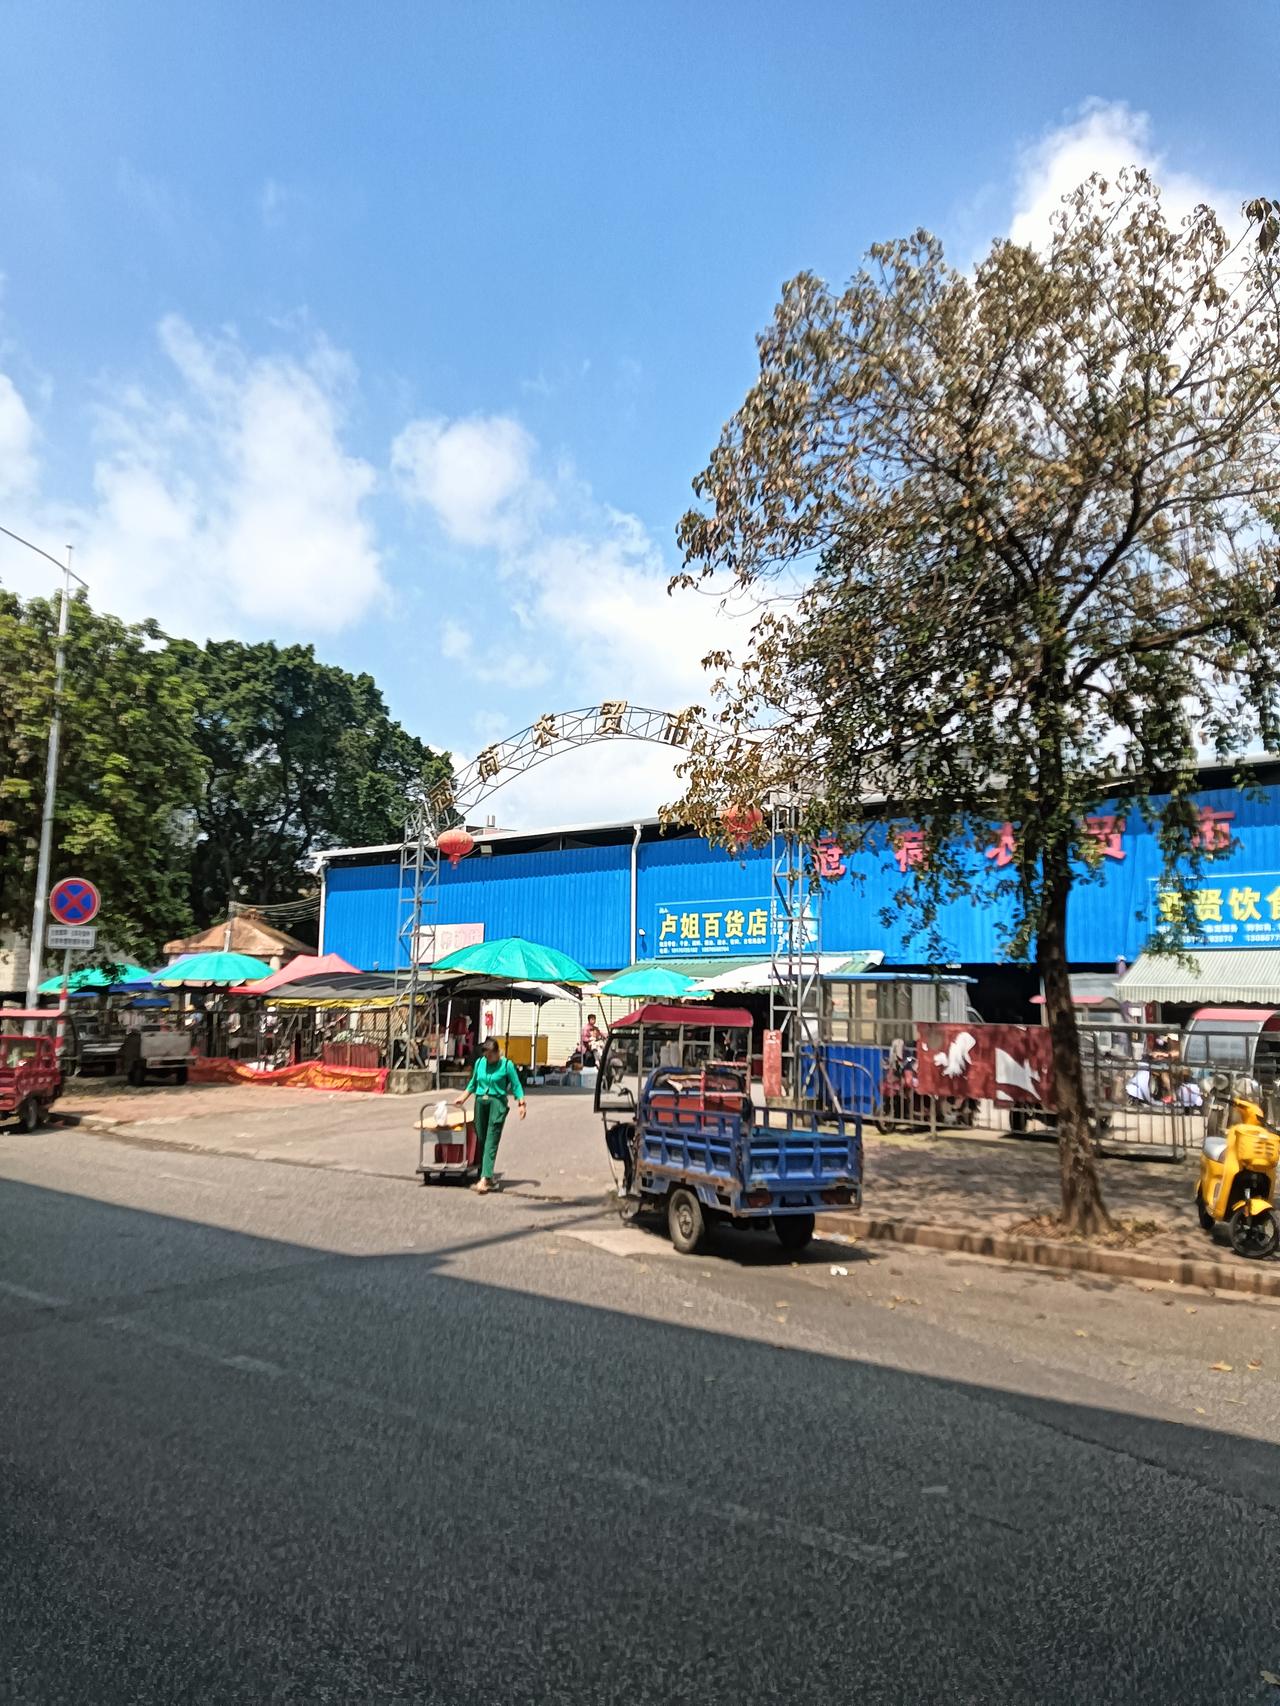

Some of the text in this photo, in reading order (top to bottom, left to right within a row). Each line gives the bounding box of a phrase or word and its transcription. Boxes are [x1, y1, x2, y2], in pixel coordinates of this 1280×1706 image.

[659, 908, 768, 940] 卢姐百货店
